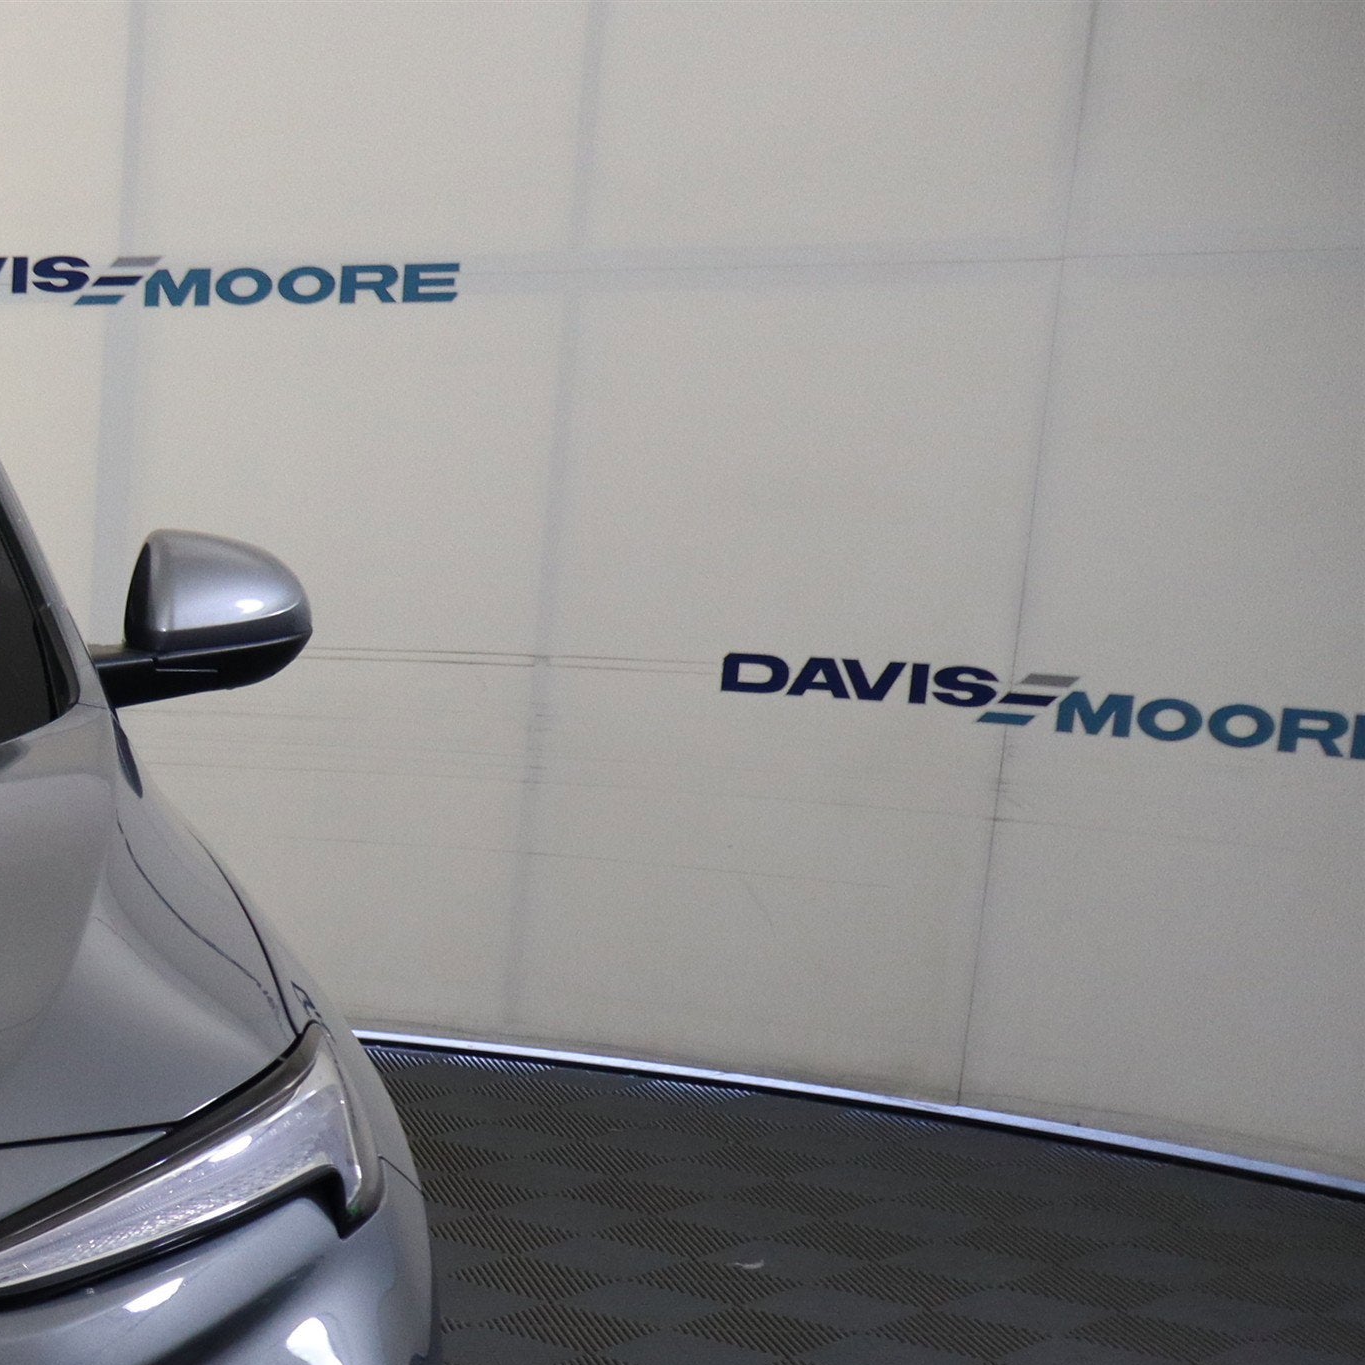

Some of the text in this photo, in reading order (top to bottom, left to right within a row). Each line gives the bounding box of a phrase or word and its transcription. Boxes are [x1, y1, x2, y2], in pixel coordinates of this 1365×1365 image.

[144, 262, 461, 307] MOORE
[720, 651, 1365, 760] DAVIS MOOR
